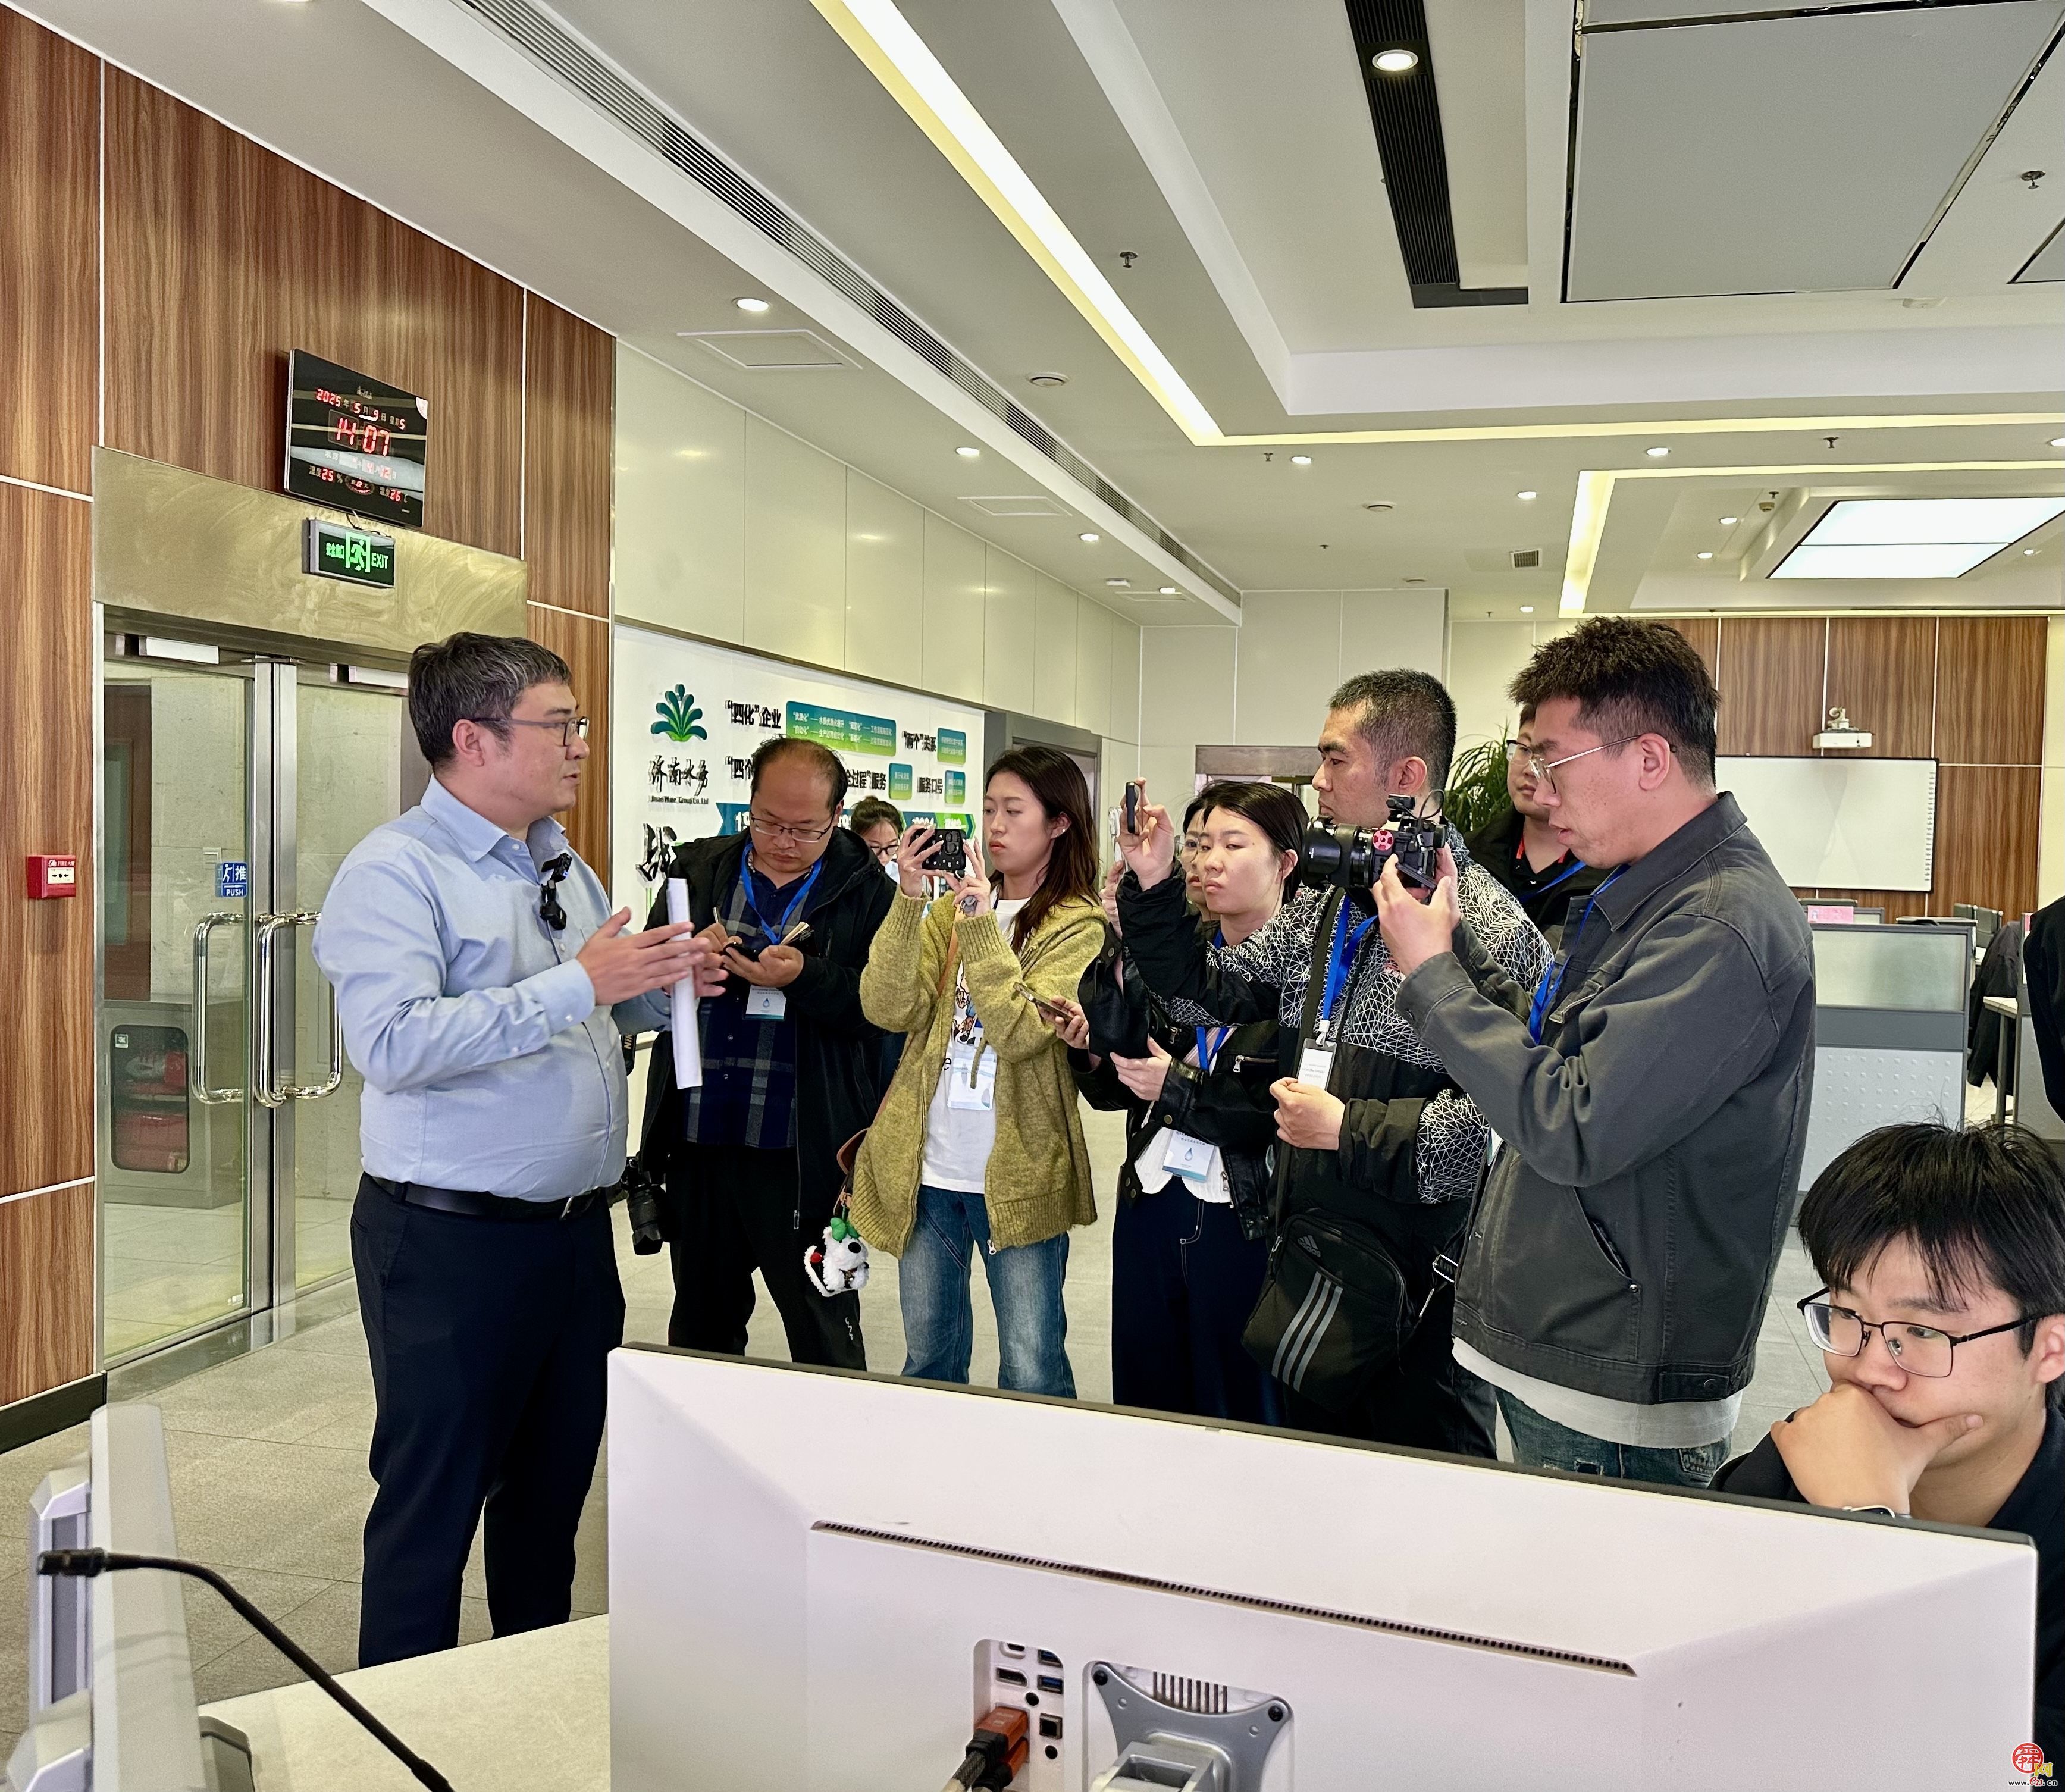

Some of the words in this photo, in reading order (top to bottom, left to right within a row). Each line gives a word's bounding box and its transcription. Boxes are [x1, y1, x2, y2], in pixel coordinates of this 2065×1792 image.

[372, 553, 388, 569] EXIT
[725, 700, 781, 729] “四化”企业
[917, 776, 943, 794] 服务口号
[235, 865, 246, 881] 推
[226, 888, 243, 897] PUSH
